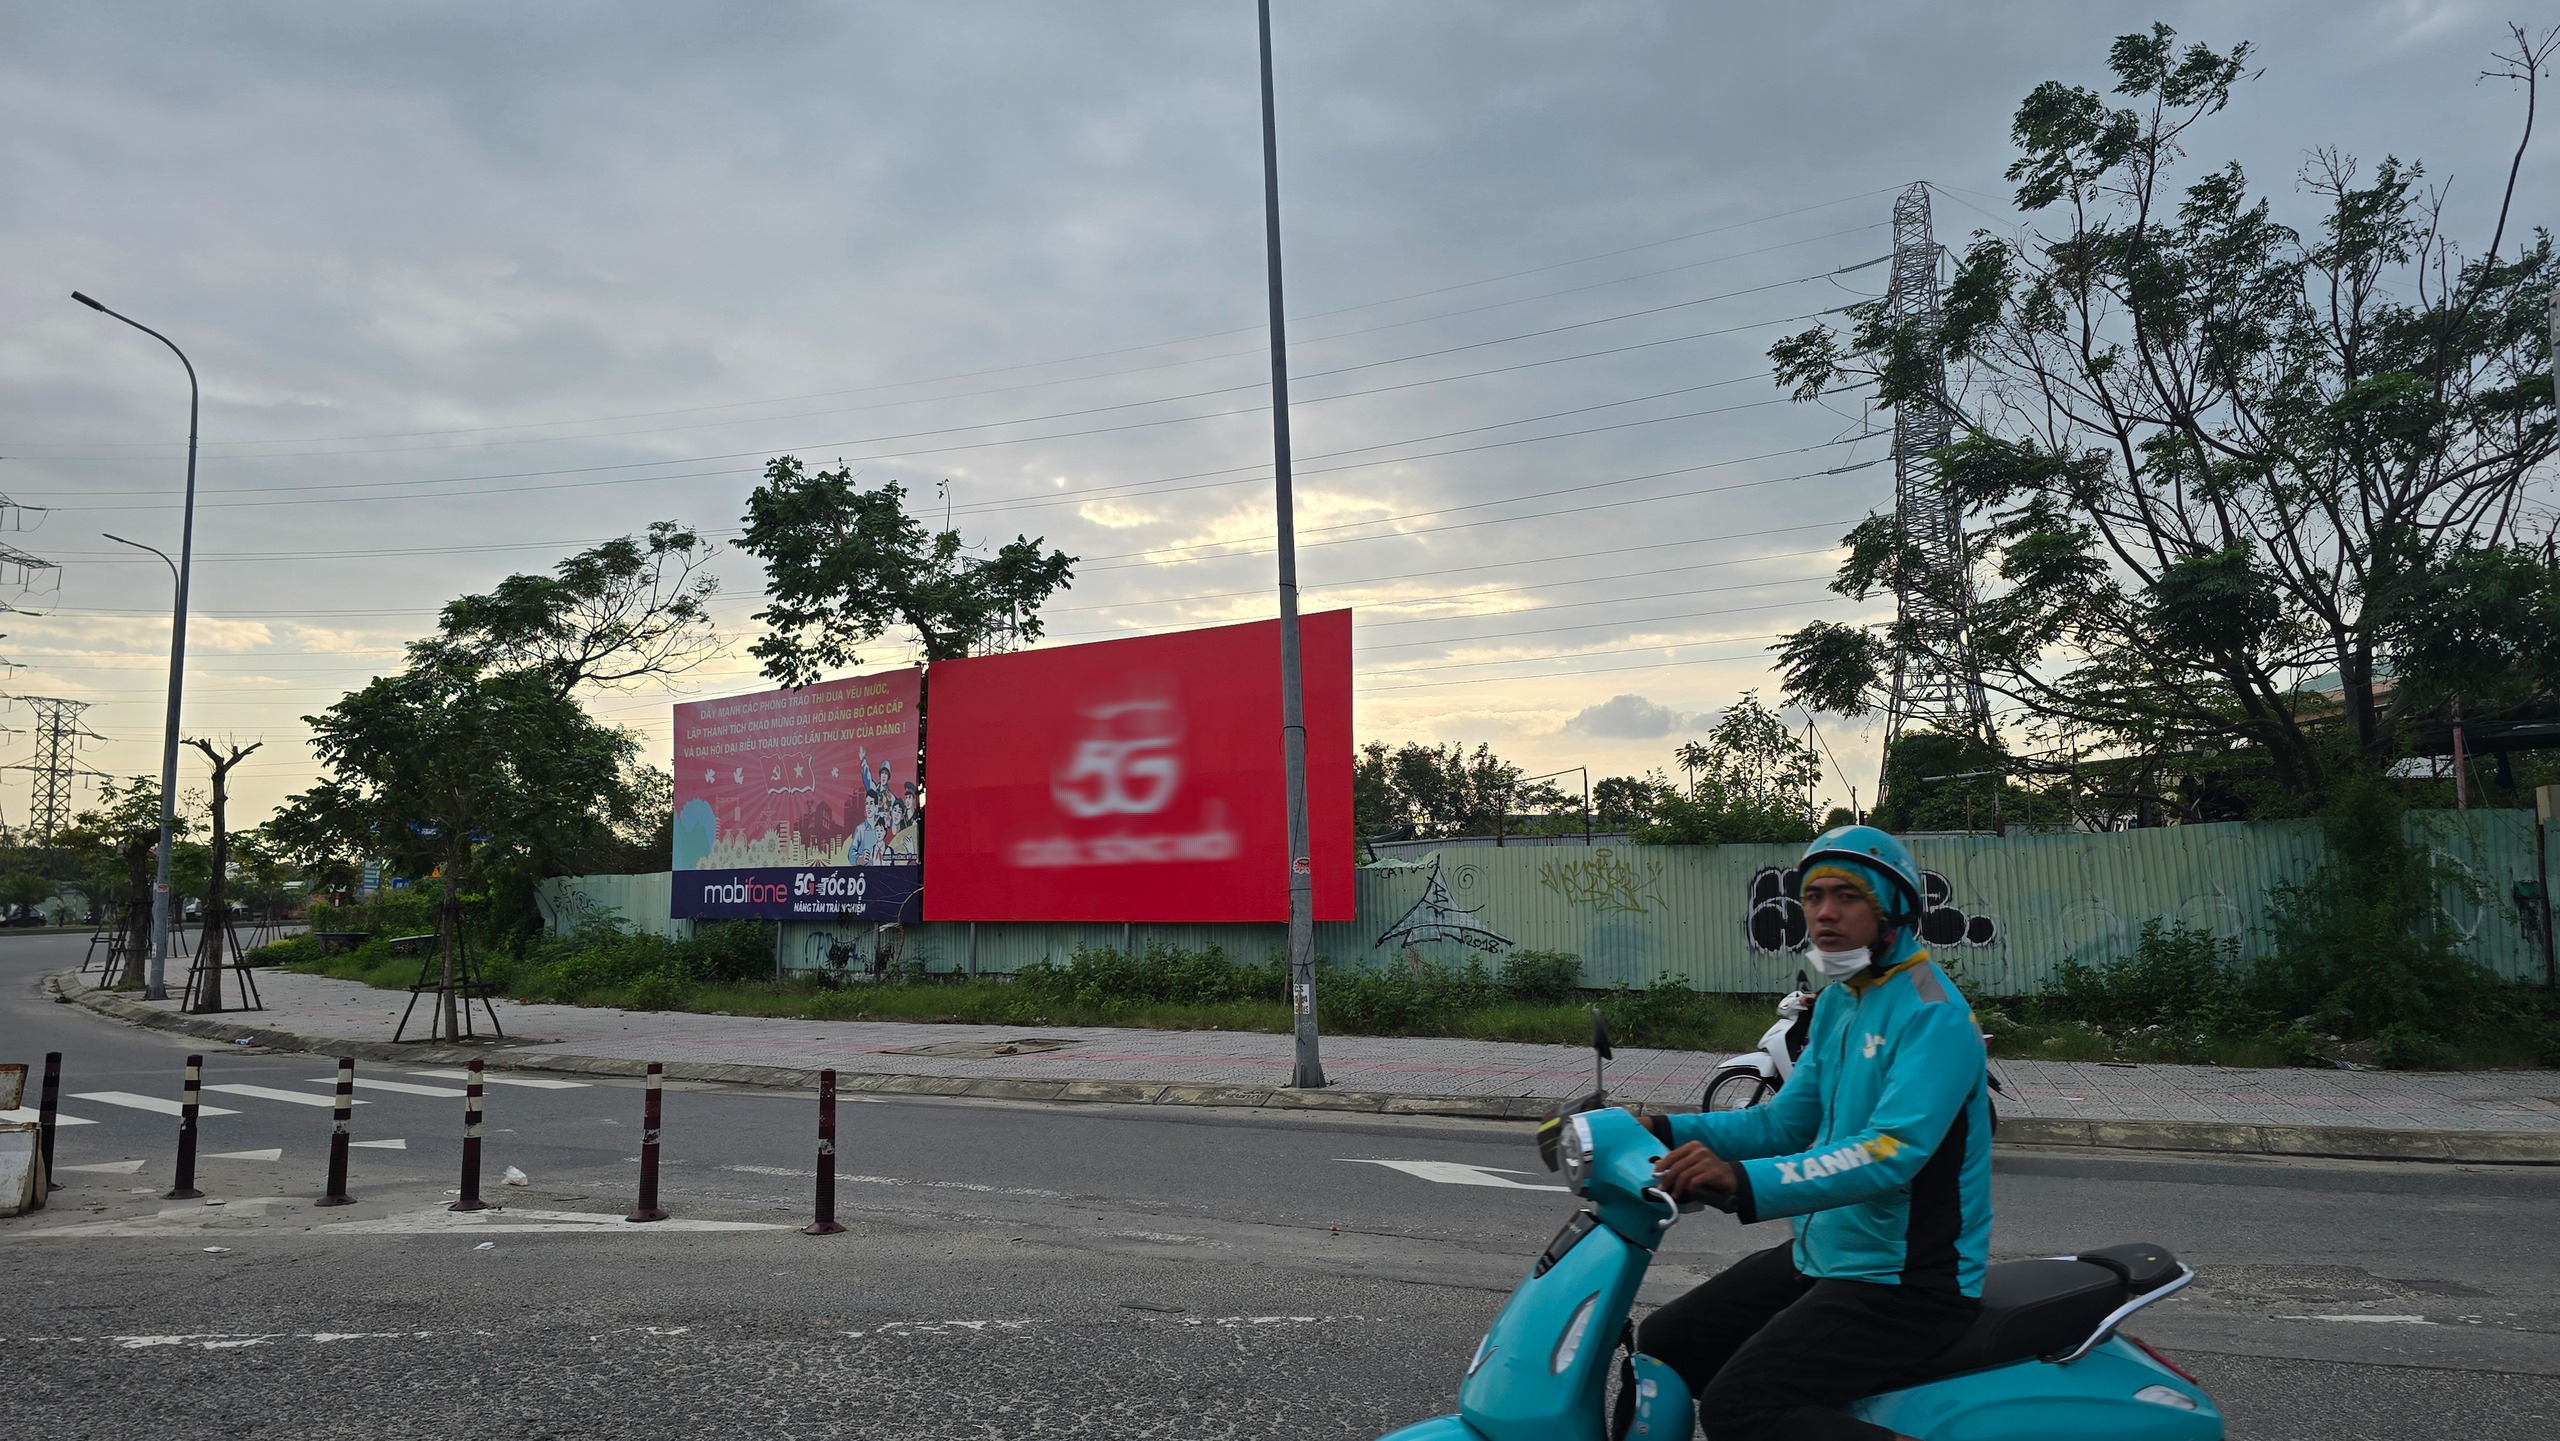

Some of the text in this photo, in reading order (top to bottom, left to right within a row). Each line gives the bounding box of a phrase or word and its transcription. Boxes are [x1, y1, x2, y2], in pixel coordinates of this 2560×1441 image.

[687, 697, 903, 742] LẬP THÀNH TÍCH CHÀO MỪNG ĐẠI HỘI ĐẢNG BỘ CÁC CẤP
[718, 704, 740, 720] MẠNH
[742, 700, 758, 714] CÁC
[760, 698, 787, 711] PHONG
[788, 693, 810, 707] TRÀO
[812, 693, 824, 704] THI
[826, 690, 844, 702] ĐUA
[846, 685, 862, 699] YÊU
[863, 681, 889, 697] NƯỚC,
[683, 745, 695, 758] VÀ
[695, 746, 709, 759] ĐẠI
[710, 743, 723, 757] HỘI
[724, 743, 738, 756] ĐẠI
[740, 735, 756, 751] BIỂU
[758, 736, 779, 749] TOÀN
[780, 731, 803, 747] QUỐC
[804, 728, 820, 744] LẦN
[823, 729, 840, 742] THỨ
[840, 728, 855, 740] XIV
[856, 722, 874, 738] CỦA
[876, 720, 901, 736] ĐẢNG
[704, 877, 788, 904] mobifone
[794, 870, 867, 901] 5G TỐC ĐỘ
[793, 900, 812, 912] NÂNG
[812, 899, 825, 912] TẦM
[826, 900, 840, 912] TRẢI
[1773, 1143, 1872, 1184] XANH
